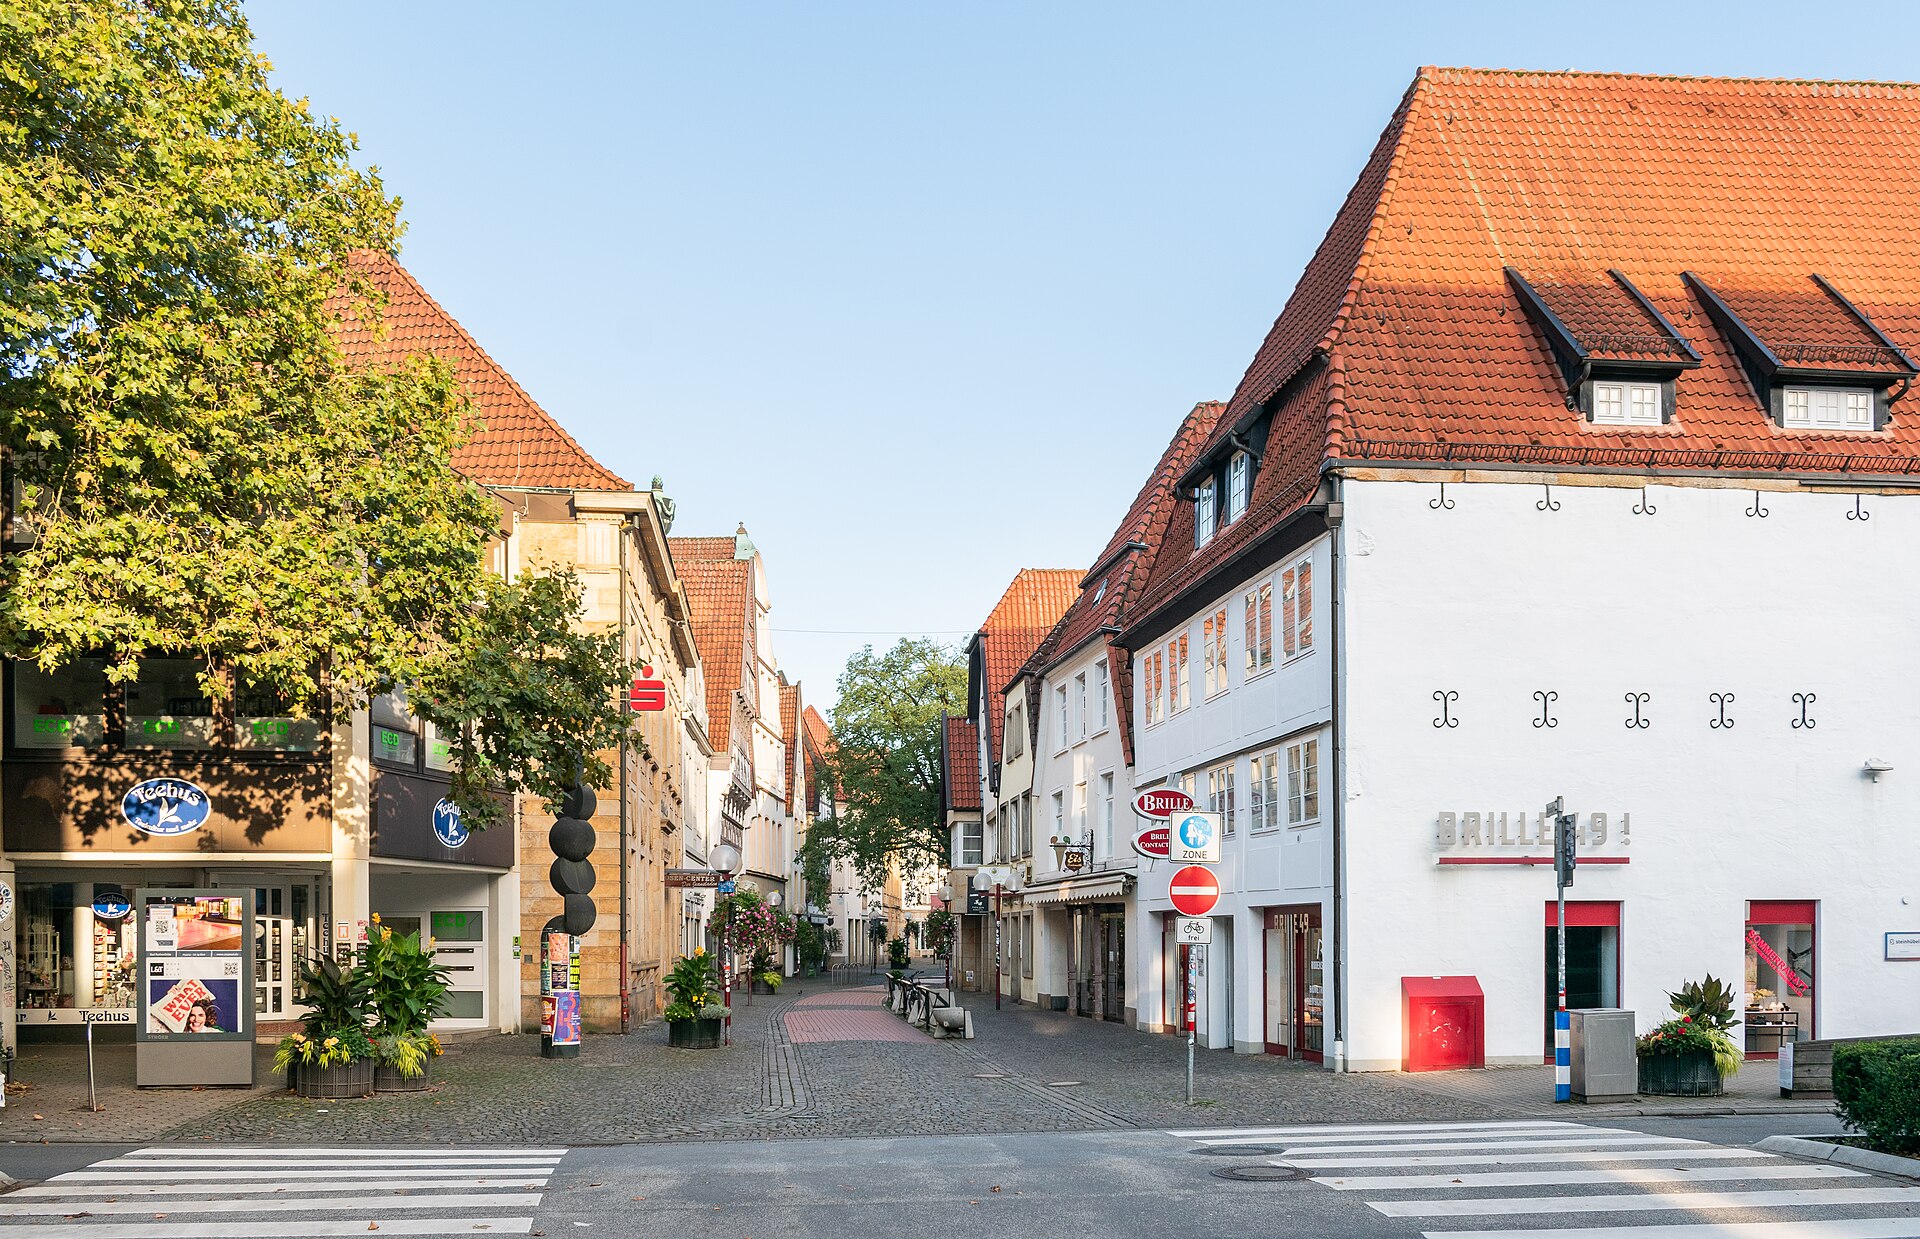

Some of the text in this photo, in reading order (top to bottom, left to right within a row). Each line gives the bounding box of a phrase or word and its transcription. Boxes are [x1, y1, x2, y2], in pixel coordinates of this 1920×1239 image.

[33, 718, 70, 733] ECD
[143, 720, 180, 734] ECD
[253, 721, 288, 735] ECD
[381, 730, 399, 746] ECD
[131, 782, 201, 807] Teehus
[1143, 794, 1190, 811] BRILLE
[1067, 853, 1082, 864] Eis
[1182, 850, 1208, 859] ZONE
[434, 913, 467, 927] ECD
[1188, 934, 1200, 942] frei
[1748, 929, 1809, 992] SOMMERRABATT
[163, 979, 198, 1013] WHAT
[171, 987, 207, 1022] EVER
[79, 1011, 130, 1022] Teehus
